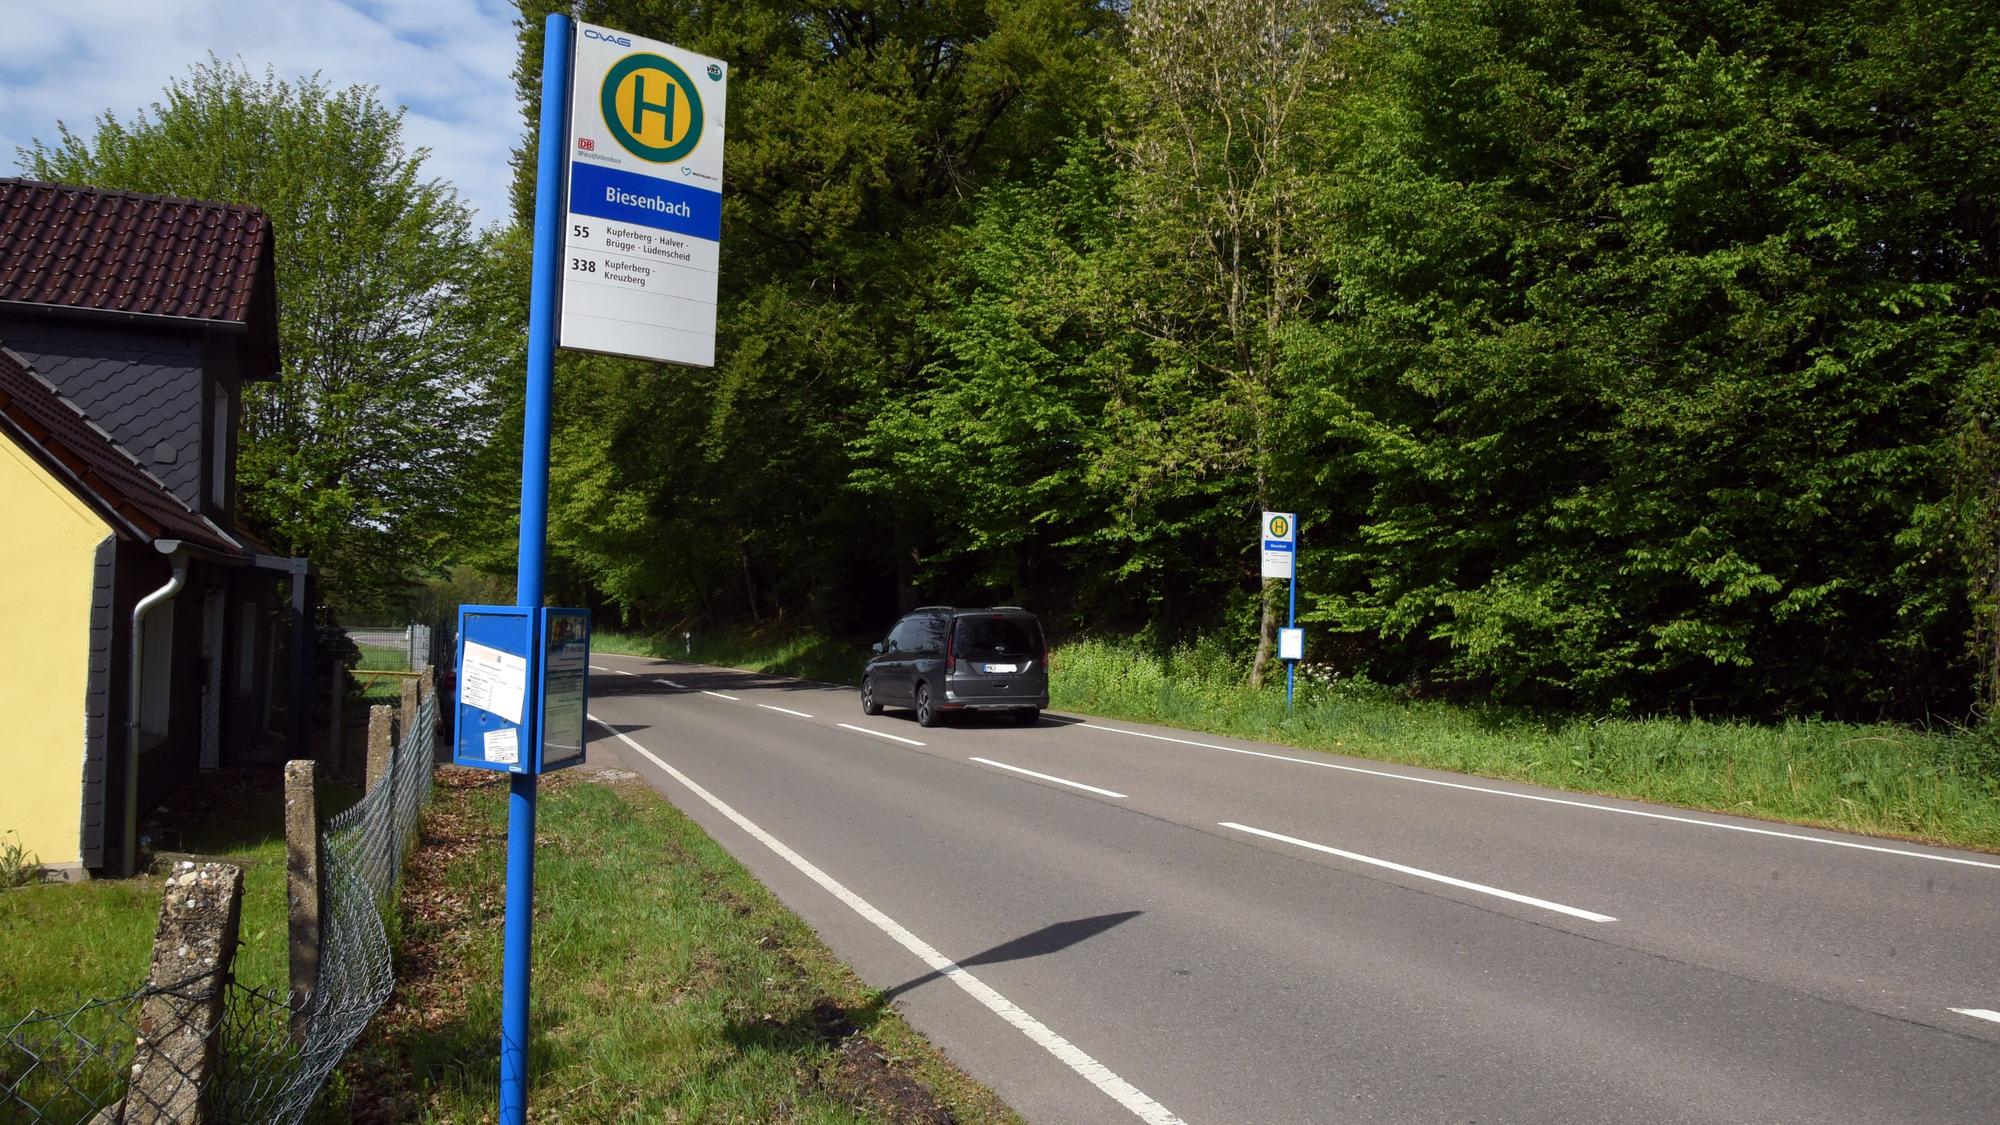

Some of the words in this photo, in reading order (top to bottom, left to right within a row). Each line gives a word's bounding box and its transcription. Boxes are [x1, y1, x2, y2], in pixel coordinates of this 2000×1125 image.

[584, 29, 631, 47] OVAG
[706, 65, 719, 75] VRS
[632, 74, 676, 142] H
[606, 186, 691, 218] Biesenbach
[573, 225, 590, 238] 55
[606, 226, 652, 244] Kupferberg
[659, 236, 684, 249] Halver
[606, 238, 636, 252] Brügge
[643, 245, 691, 262] Lüdenscheid
[571, 258, 596, 273] 338
[604, 260, 651, 277] Kupferberg
[604, 271, 646, 288] Kreuzberg
[1274, 520, 1284, 533] H
